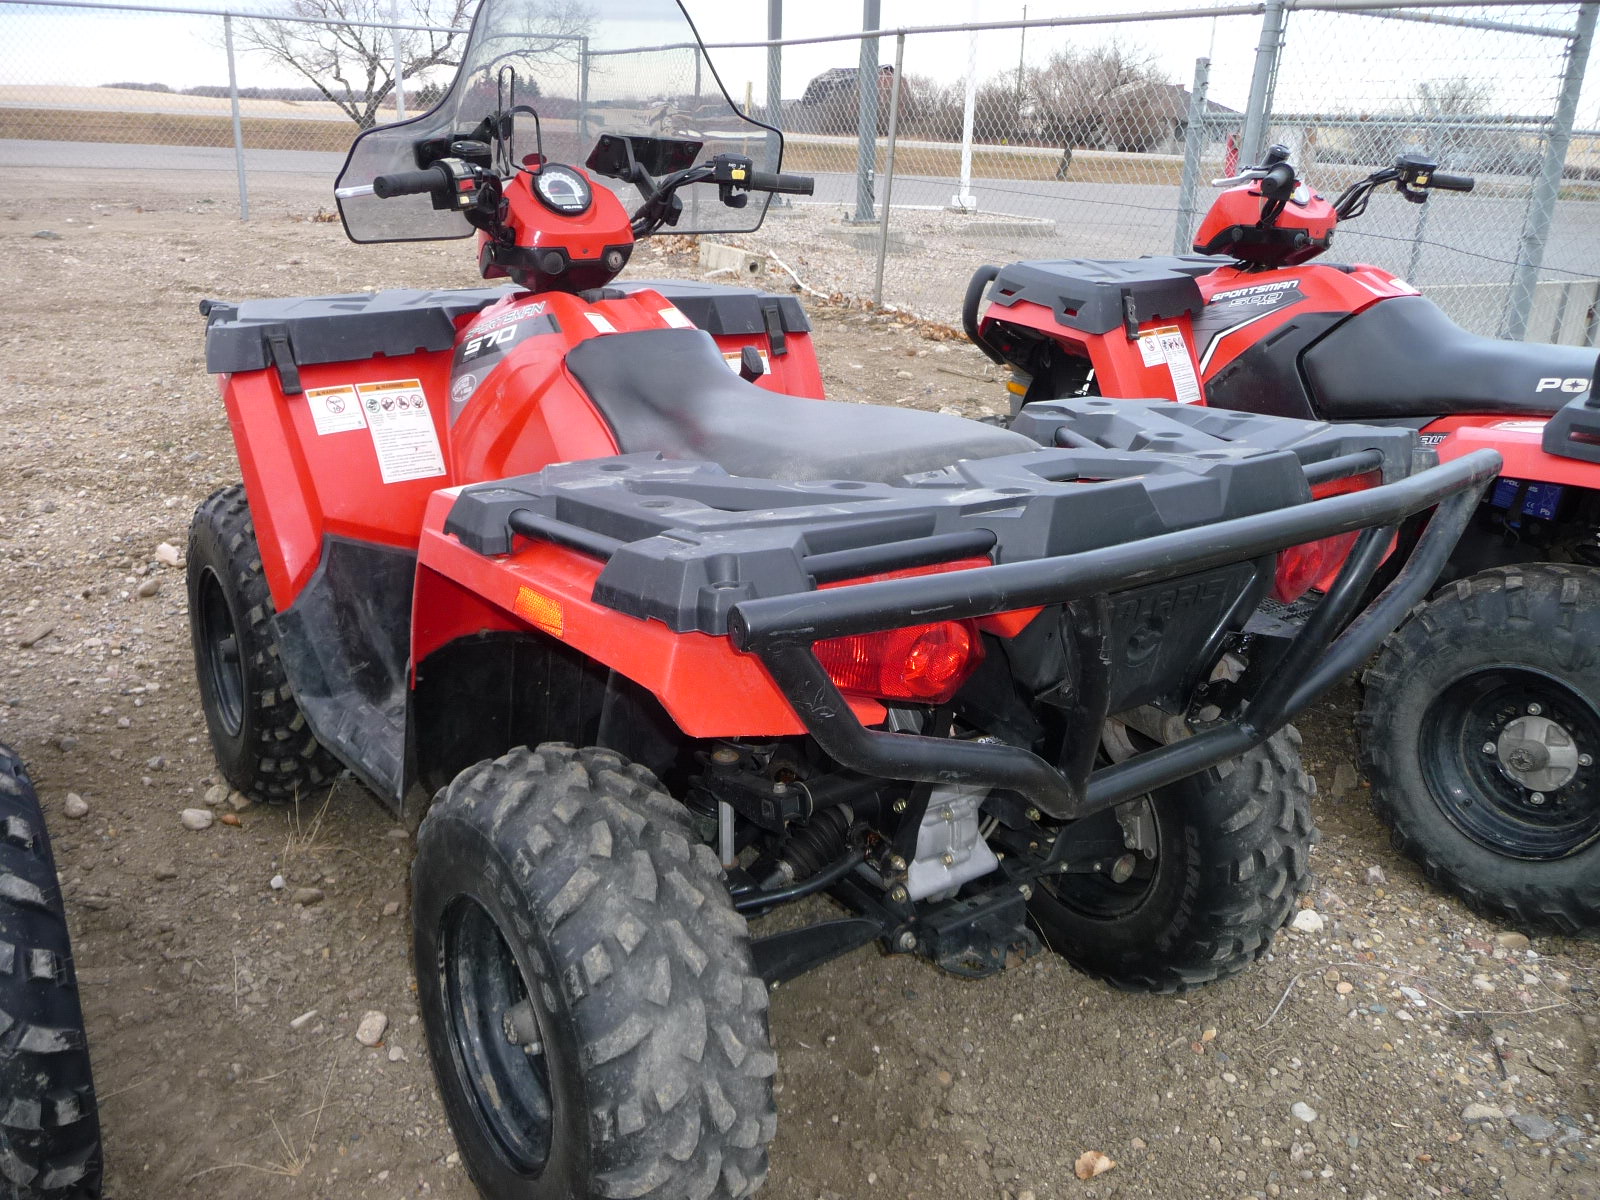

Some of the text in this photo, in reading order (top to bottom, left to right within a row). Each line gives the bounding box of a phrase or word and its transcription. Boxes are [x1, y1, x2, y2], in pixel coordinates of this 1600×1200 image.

[1211, 280, 1299, 302] SPORTSMAN
[1229, 291, 1284, 308] 500
[463, 301, 546, 339] SPORTSMAN
[464, 324, 518, 356] 570
